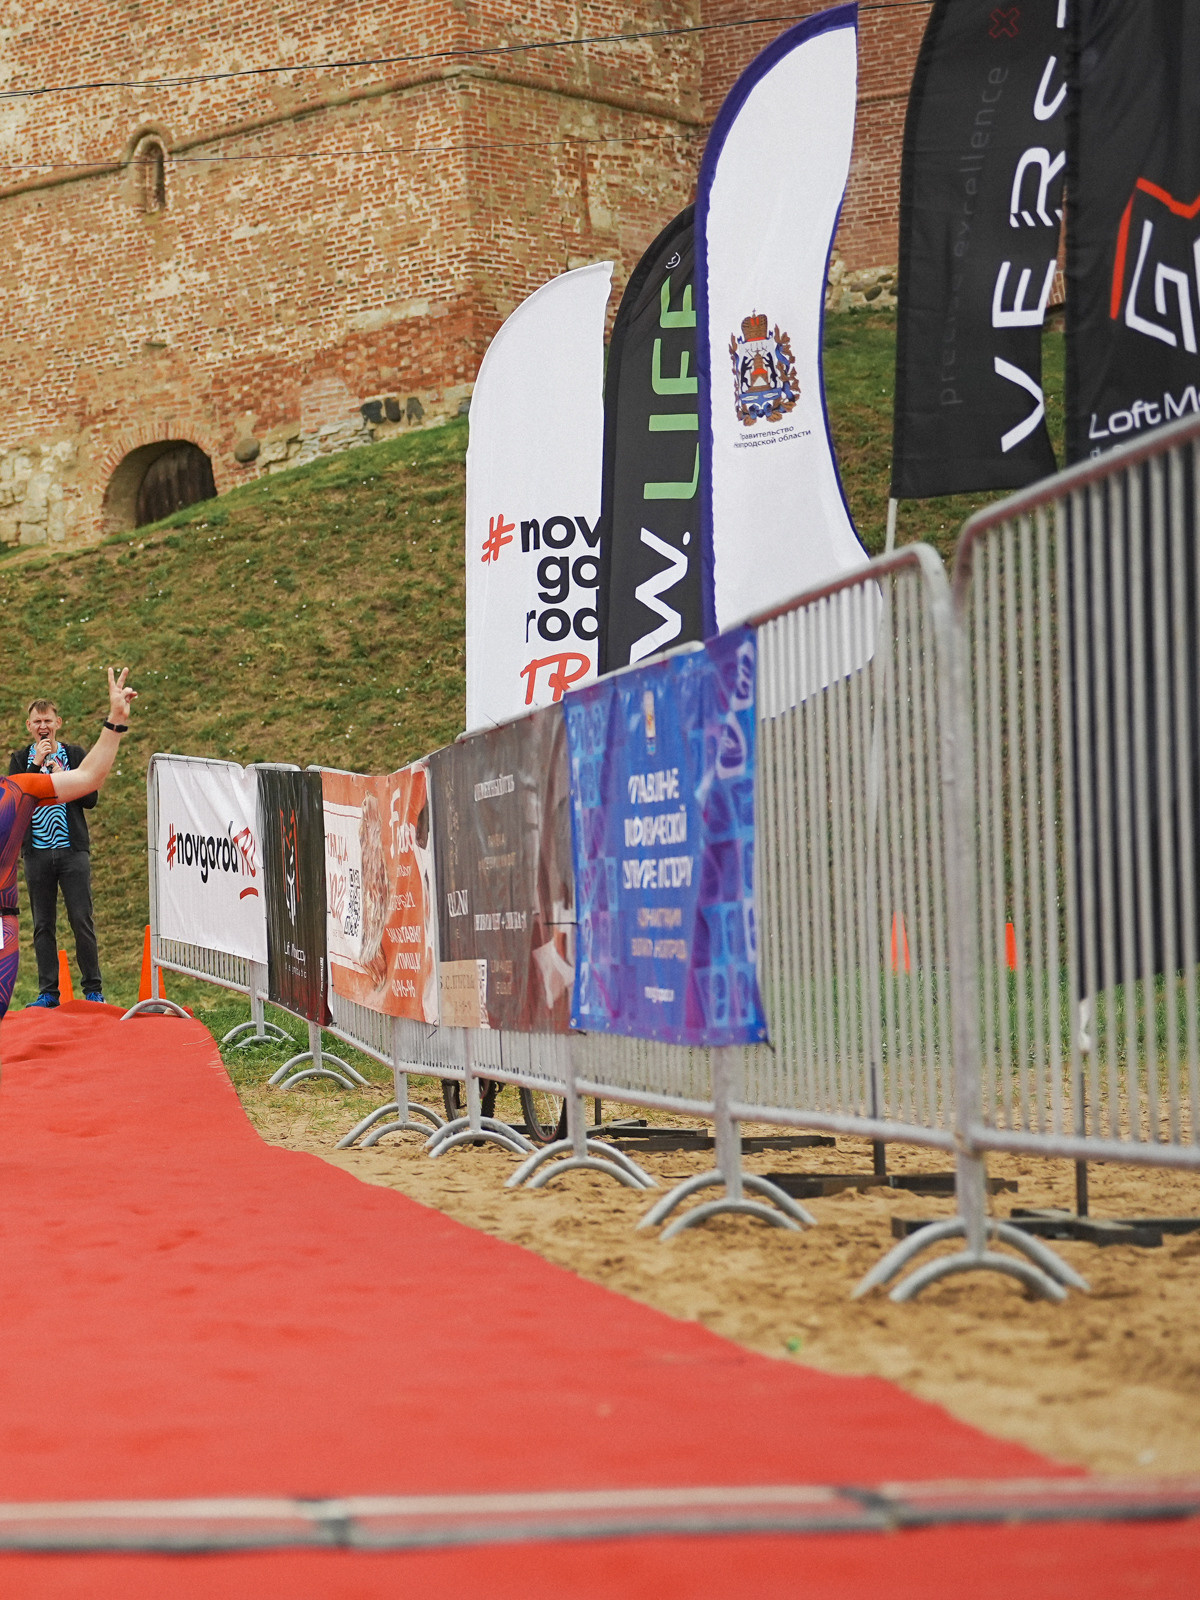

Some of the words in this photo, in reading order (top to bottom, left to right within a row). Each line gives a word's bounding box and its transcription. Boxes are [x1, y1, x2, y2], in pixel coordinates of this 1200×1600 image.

[778, 430, 811, 442] области
[1089, 400, 1161, 440] Loft
[481, 513, 601, 566] #nov
[537, 555, 601, 605] go
